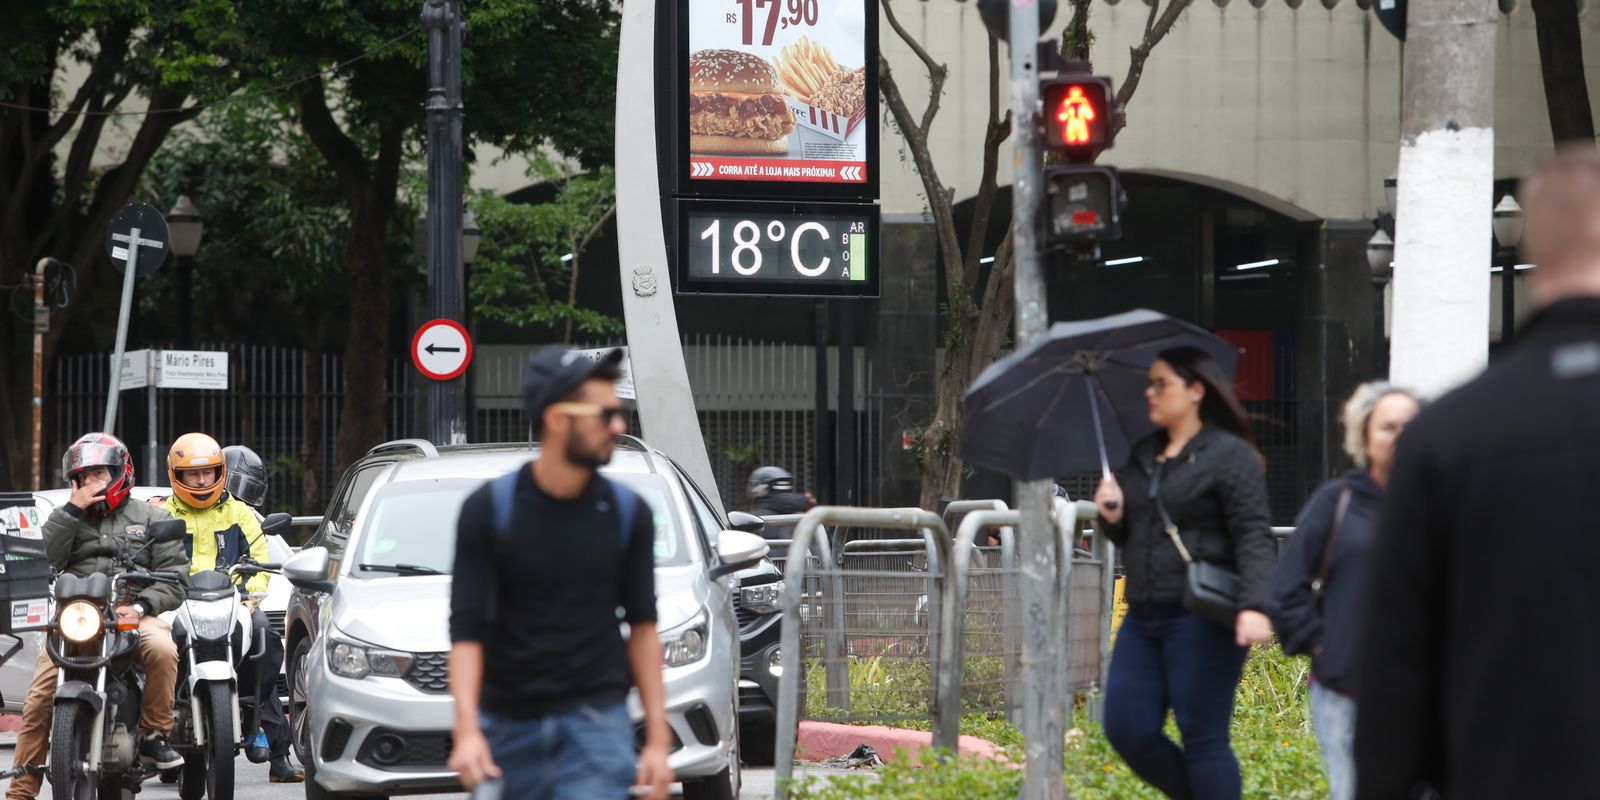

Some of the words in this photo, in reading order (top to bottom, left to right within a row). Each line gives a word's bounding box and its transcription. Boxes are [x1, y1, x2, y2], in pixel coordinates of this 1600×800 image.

[726, 13, 737, 24] R$
[719, 165, 743, 175] CORRA
[744, 164, 758, 176] ATÉ
[759, 166, 764, 176] A
[765, 166, 783, 176] LOJA
[783, 166, 801, 177] MAIS
[801, 165, 836, 178] PRÓXIMA!
[850, 222, 865, 233] AR
[166, 353, 190, 368] Mário
[193, 354, 215, 368] Pires
